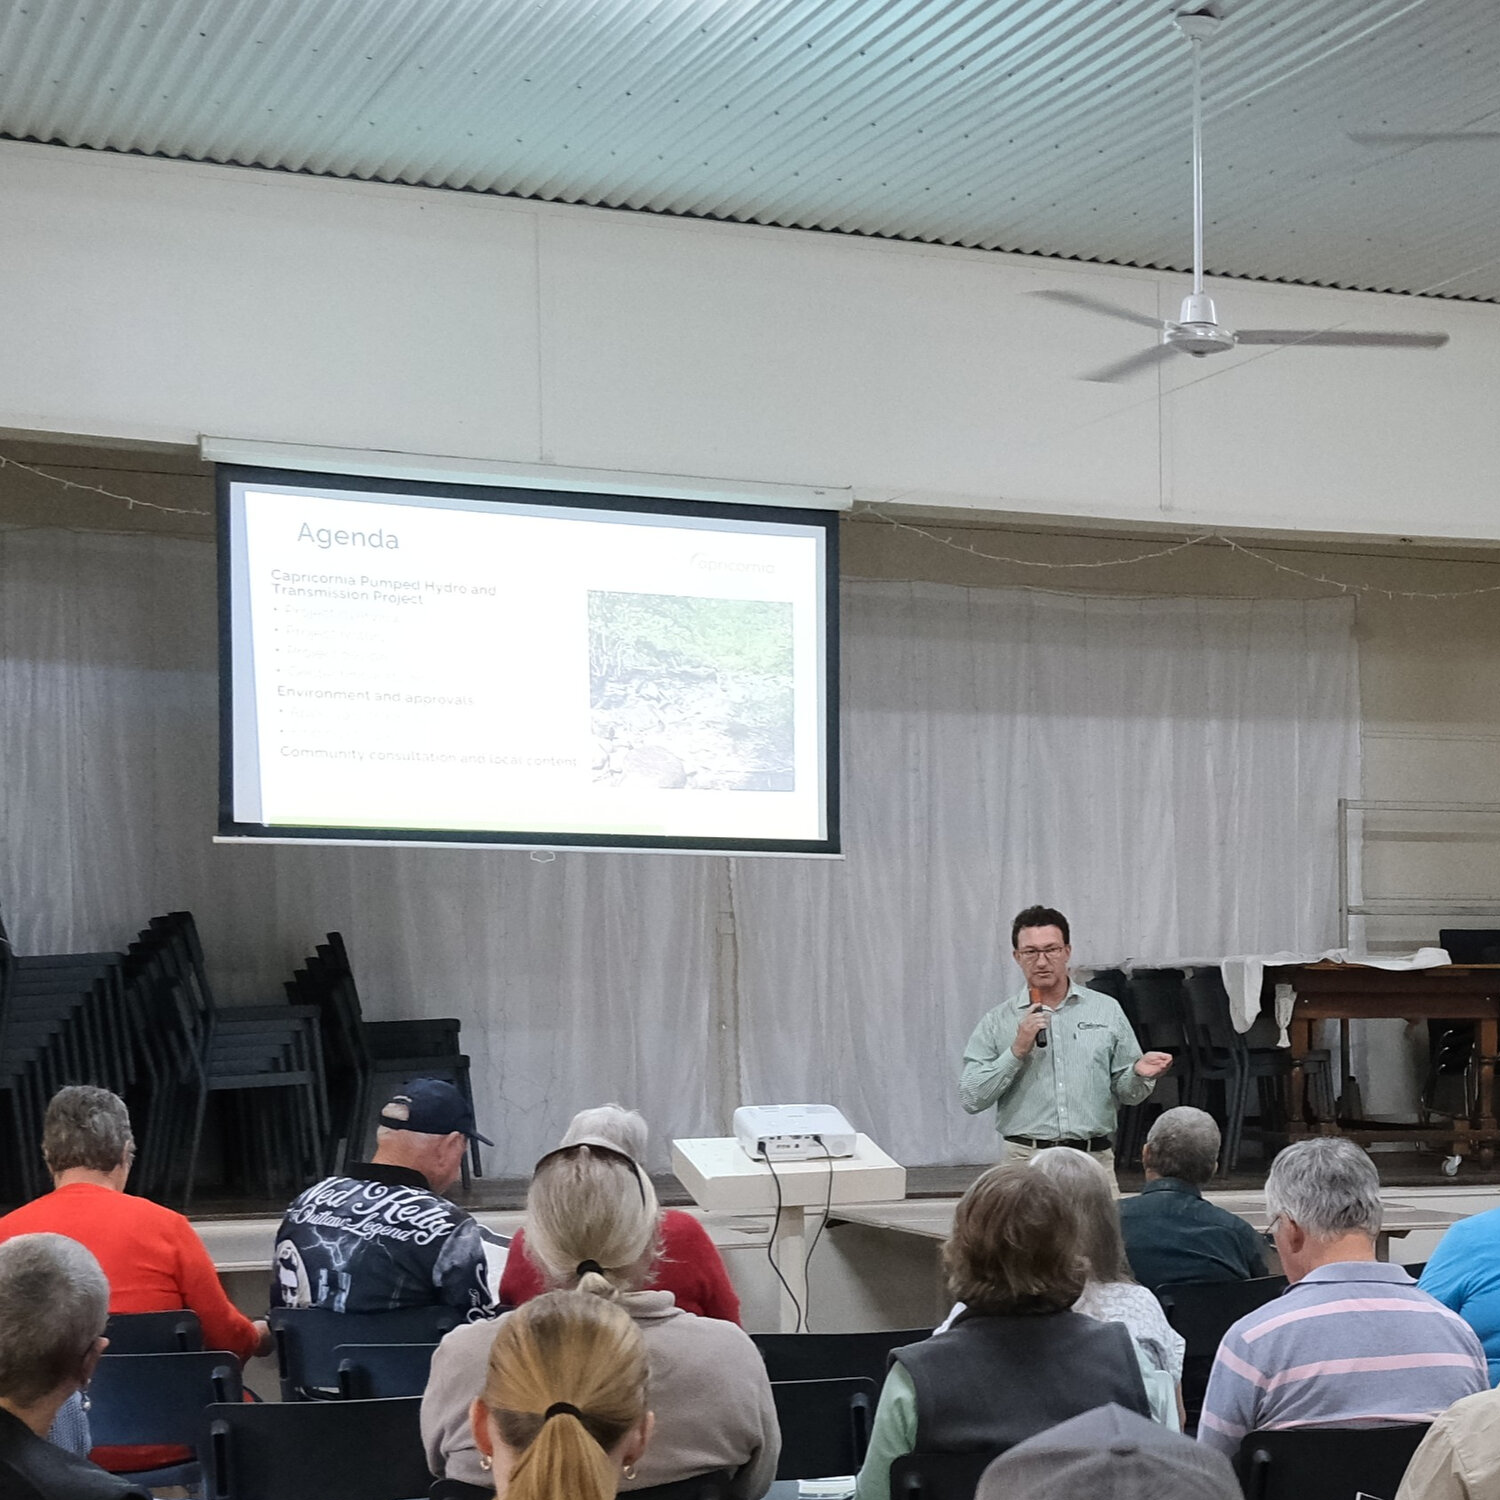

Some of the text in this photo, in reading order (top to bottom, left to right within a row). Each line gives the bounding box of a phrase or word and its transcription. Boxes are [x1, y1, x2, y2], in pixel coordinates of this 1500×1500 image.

[297, 522, 400, 550] Agenda
[271, 569, 496, 597] Capricornia Pumped Hydro and
[272, 583, 423, 606] Transmission Project
[277, 685, 474, 707] Environment and approvals
[280, 746, 364, 762] Community
[369, 749, 456, 764] consultation
[460, 752, 485, 765] and
[301, 1176, 456, 1246] Ned Kelly
[342, 1212, 416, 1242] Legend
